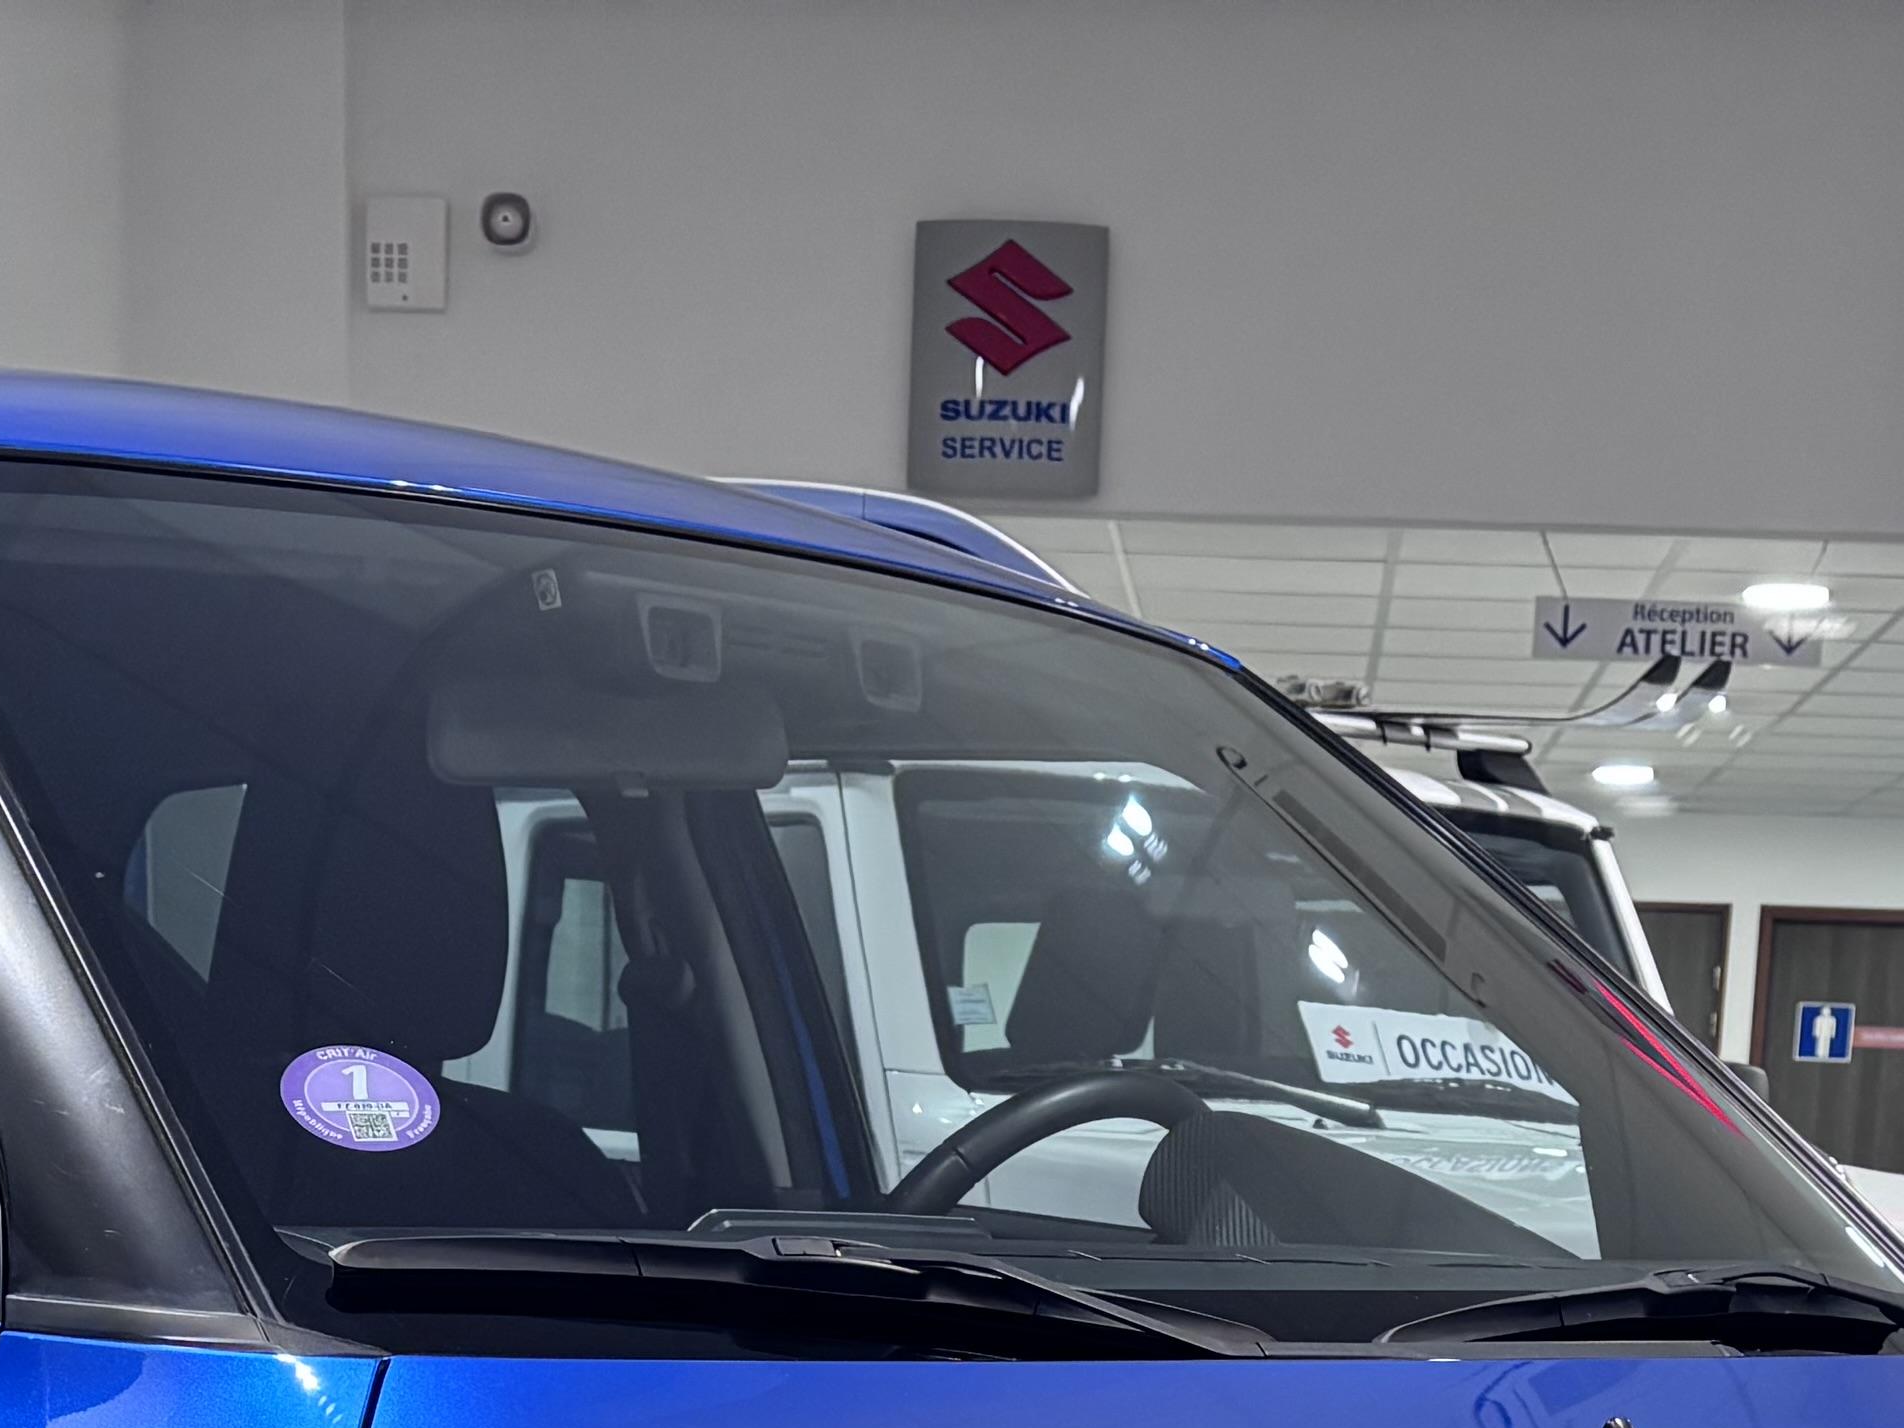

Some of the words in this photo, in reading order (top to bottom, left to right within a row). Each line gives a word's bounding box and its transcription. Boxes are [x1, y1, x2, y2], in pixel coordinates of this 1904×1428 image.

[940, 399, 1070, 425] SUZUKI
[942, 437, 1064, 462] SERVICE
[1633, 602, 1735, 624] Réception
[1617, 628, 1750, 658] ATELIER
[1326, 1050, 1374, 1065] SUZUKI
[341, 1064, 369, 1100] 1
